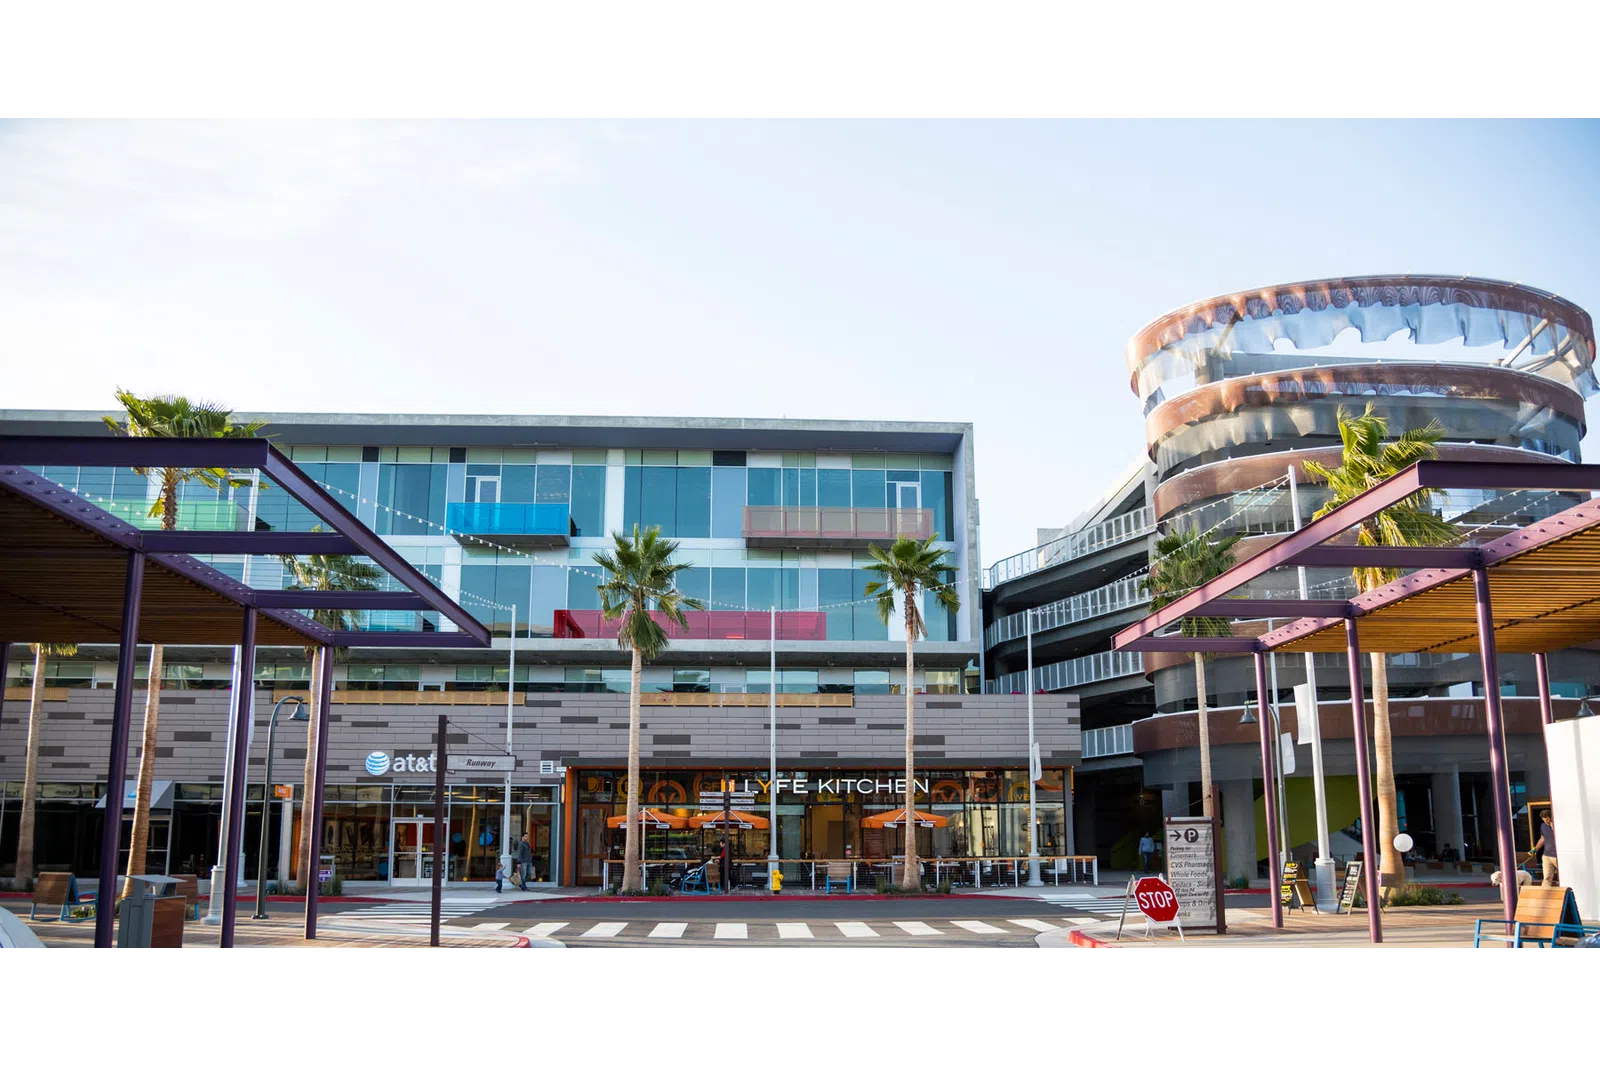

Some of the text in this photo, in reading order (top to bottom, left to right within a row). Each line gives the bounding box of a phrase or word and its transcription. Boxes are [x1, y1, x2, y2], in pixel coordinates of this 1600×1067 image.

[393, 754, 437, 772] at&t
[466, 758, 497, 768] Runway
[744, 779, 809, 794] LYFE
[818, 779, 929, 794] KITCHEN
[1170, 851, 1197, 859] Cinemark
[1190, 870, 1207, 878] Foods
[1138, 891, 1173, 909] STOP
